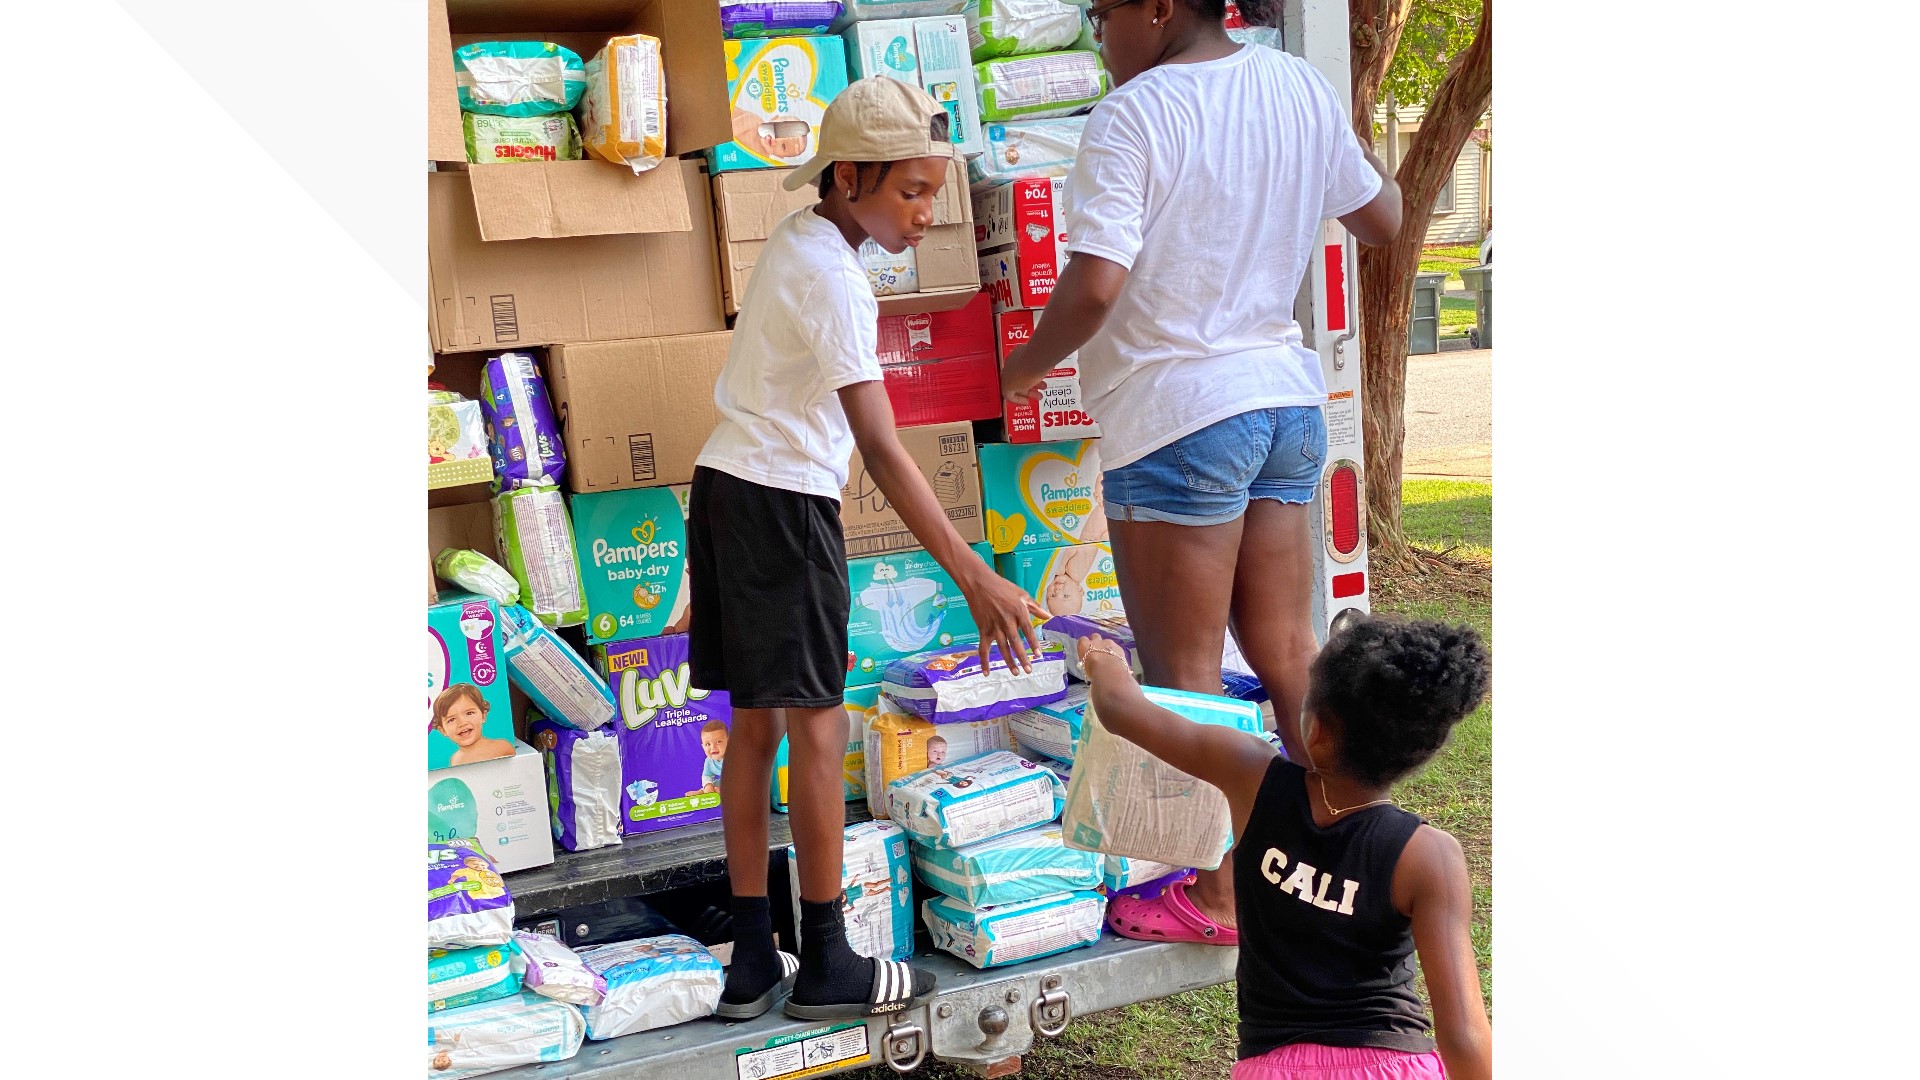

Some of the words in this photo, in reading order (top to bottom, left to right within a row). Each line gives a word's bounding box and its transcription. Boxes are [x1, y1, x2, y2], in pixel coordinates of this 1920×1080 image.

[875, 41, 884, 75] sensitiv
[761, 63, 772, 111] swaddlers
[772, 57, 790, 113] Pampers
[494, 145, 557, 161] HUGGIES
[1025, 188, 1048, 200] 704
[1040, 209, 1049, 218] 11
[1029, 278, 1056, 287] VALUE
[1007, 329, 1030, 340] 704
[1043, 388, 1072, 397] clean.
[1043, 398, 1076, 408] simply
[1043, 409, 1095, 428] GGIES
[943, 442, 966, 454] 98731
[1040, 483, 1092, 502] Pampers
[1046, 502, 1090, 514] swaddlers
[1000, 526, 1007, 541] 1
[1022, 534, 1037, 545] 96
[592, 538, 679, 568] Pampers
[607, 564, 670, 581] baby-dry
[1087, 575, 1116, 586] ddlers
[1086, 587, 1120, 602] mpers
[599, 615, 611, 631] 6
[619, 614, 635, 627] 64
[613, 651, 645, 669] NEW!
[665, 708, 691, 720] Triple
[655, 714, 708, 728] Leakguards
[437, 802, 465, 813] Pampers
[1260, 847, 1360, 916] CALI
[870, 1002, 907, 1015] adidas
